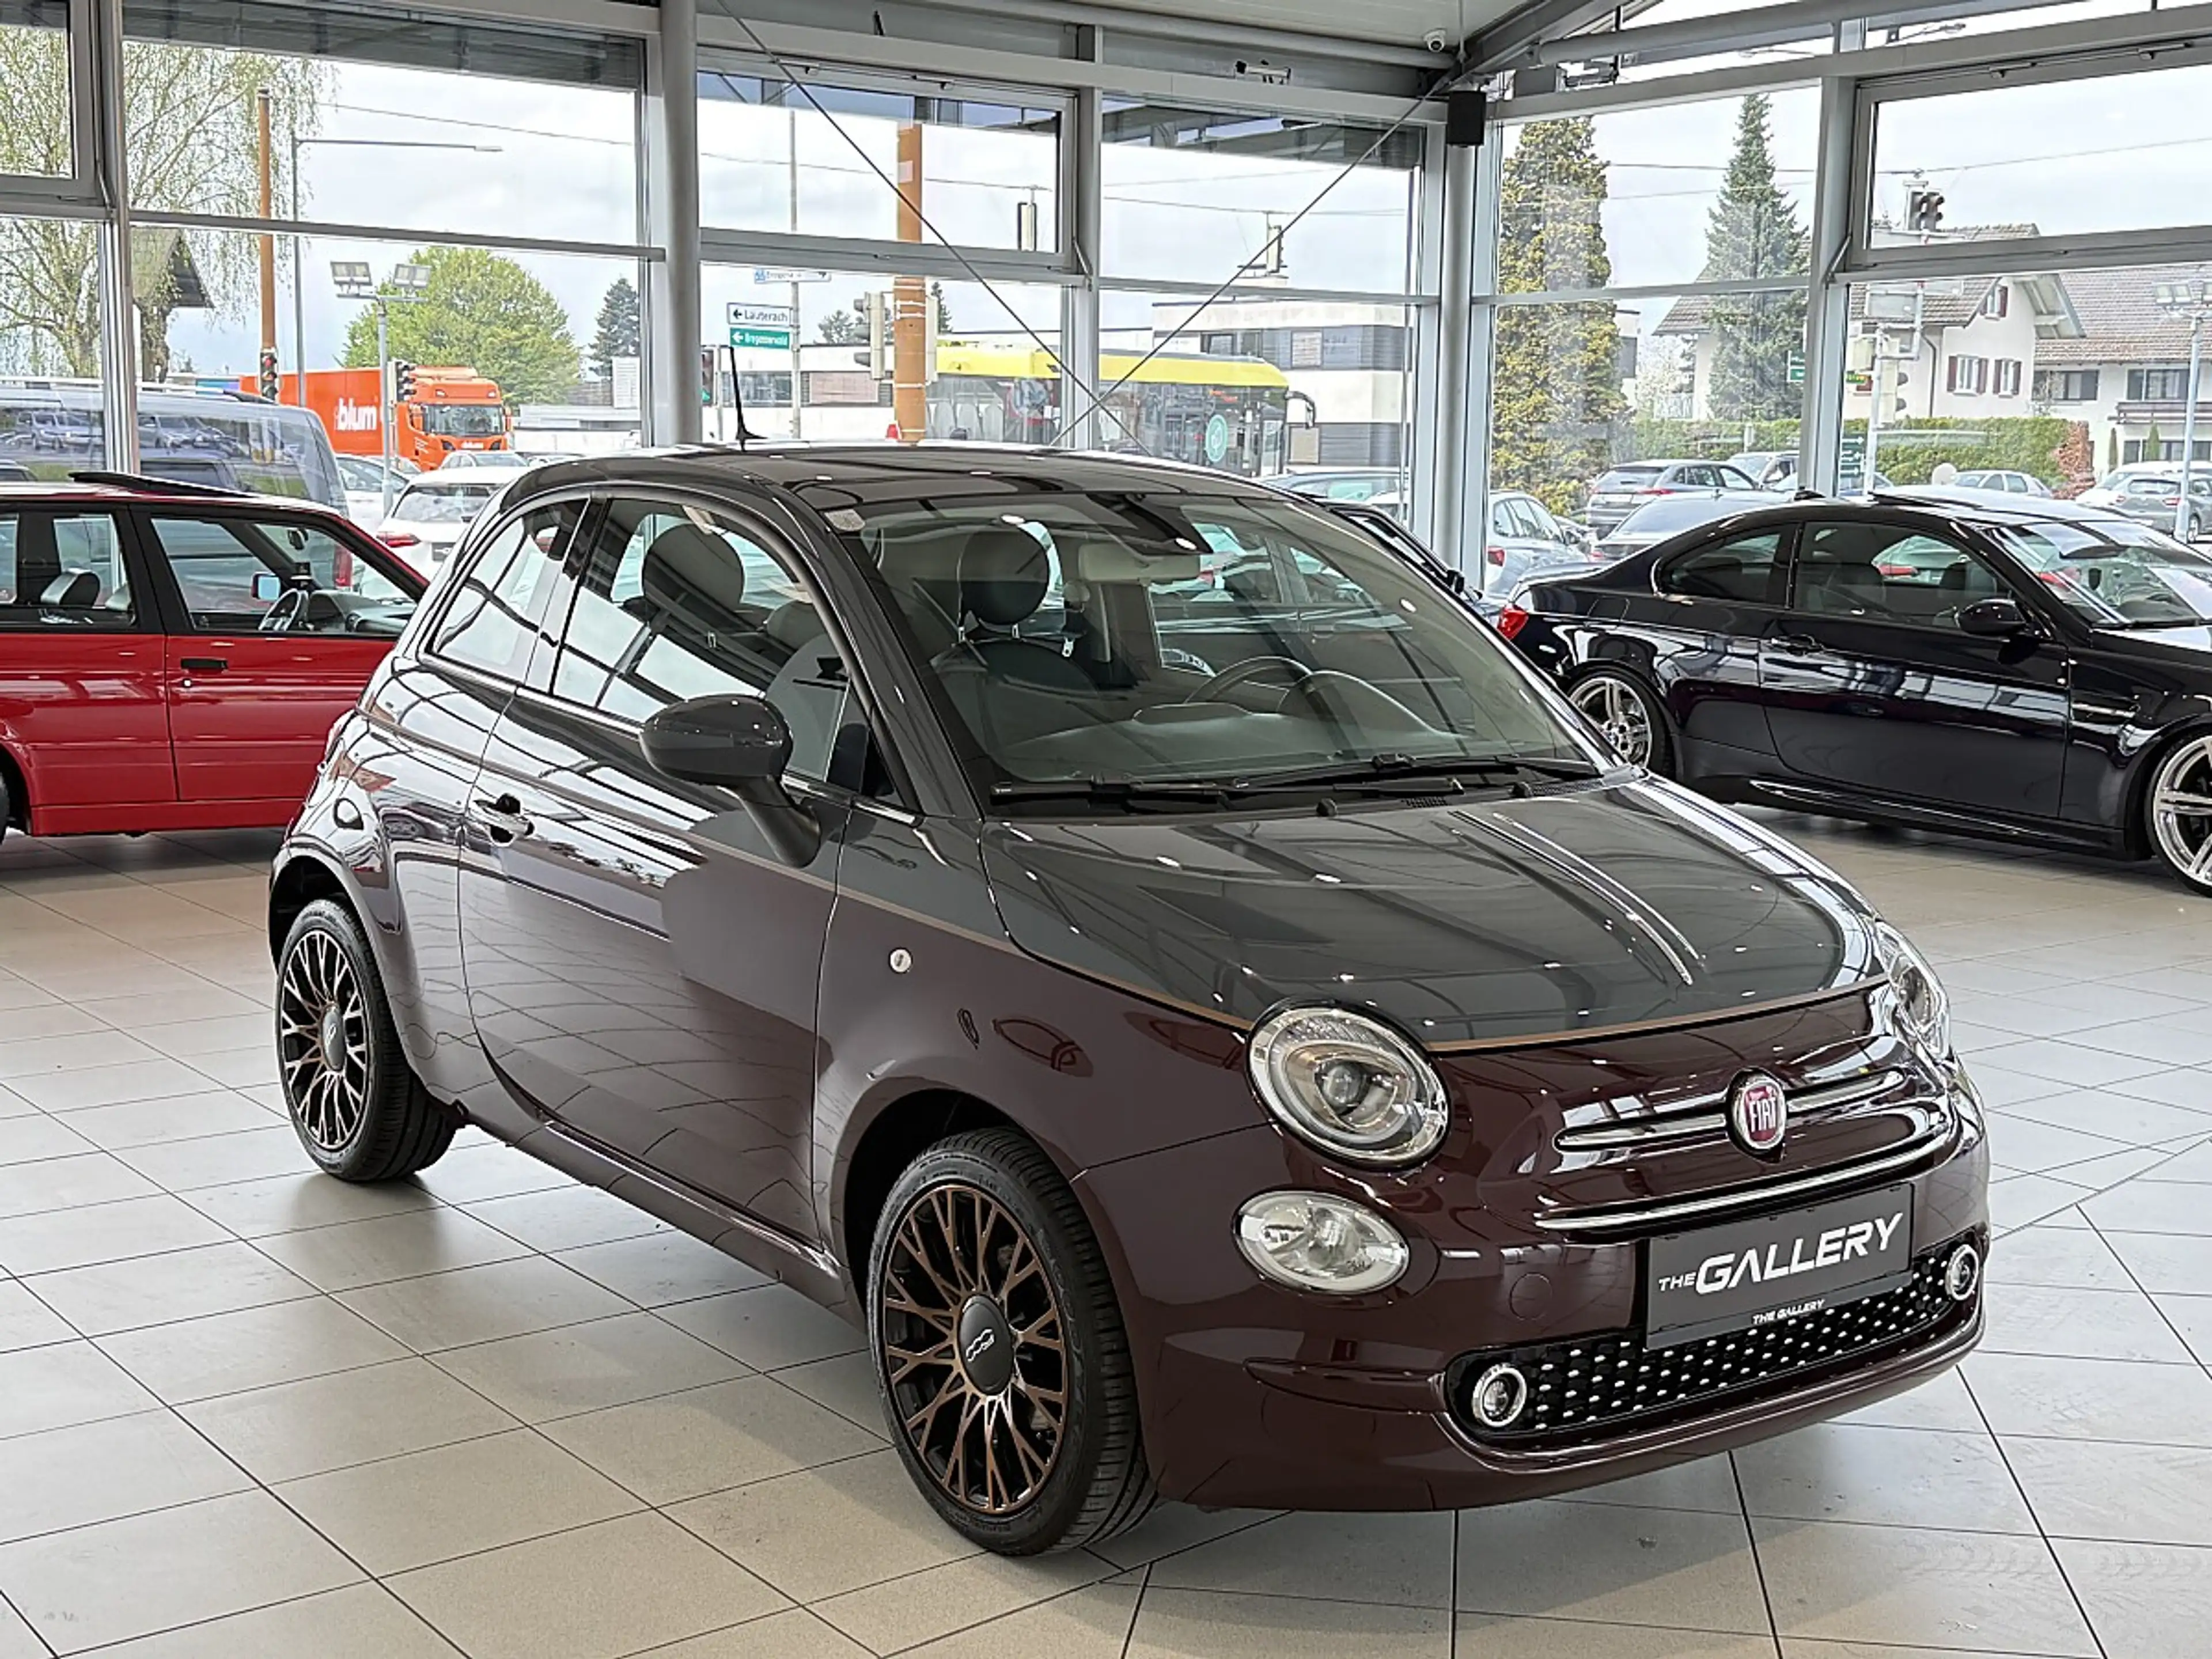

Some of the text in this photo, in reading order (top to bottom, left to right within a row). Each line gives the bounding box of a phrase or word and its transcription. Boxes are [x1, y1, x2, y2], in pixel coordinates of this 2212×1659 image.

[337, 397, 377, 431] blum
[1749, 1097, 1777, 1133] FIAT
[1658, 1212, 1903, 1295] THE GALLERY
[1752, 1298, 1825, 1325] THE GALLERY
